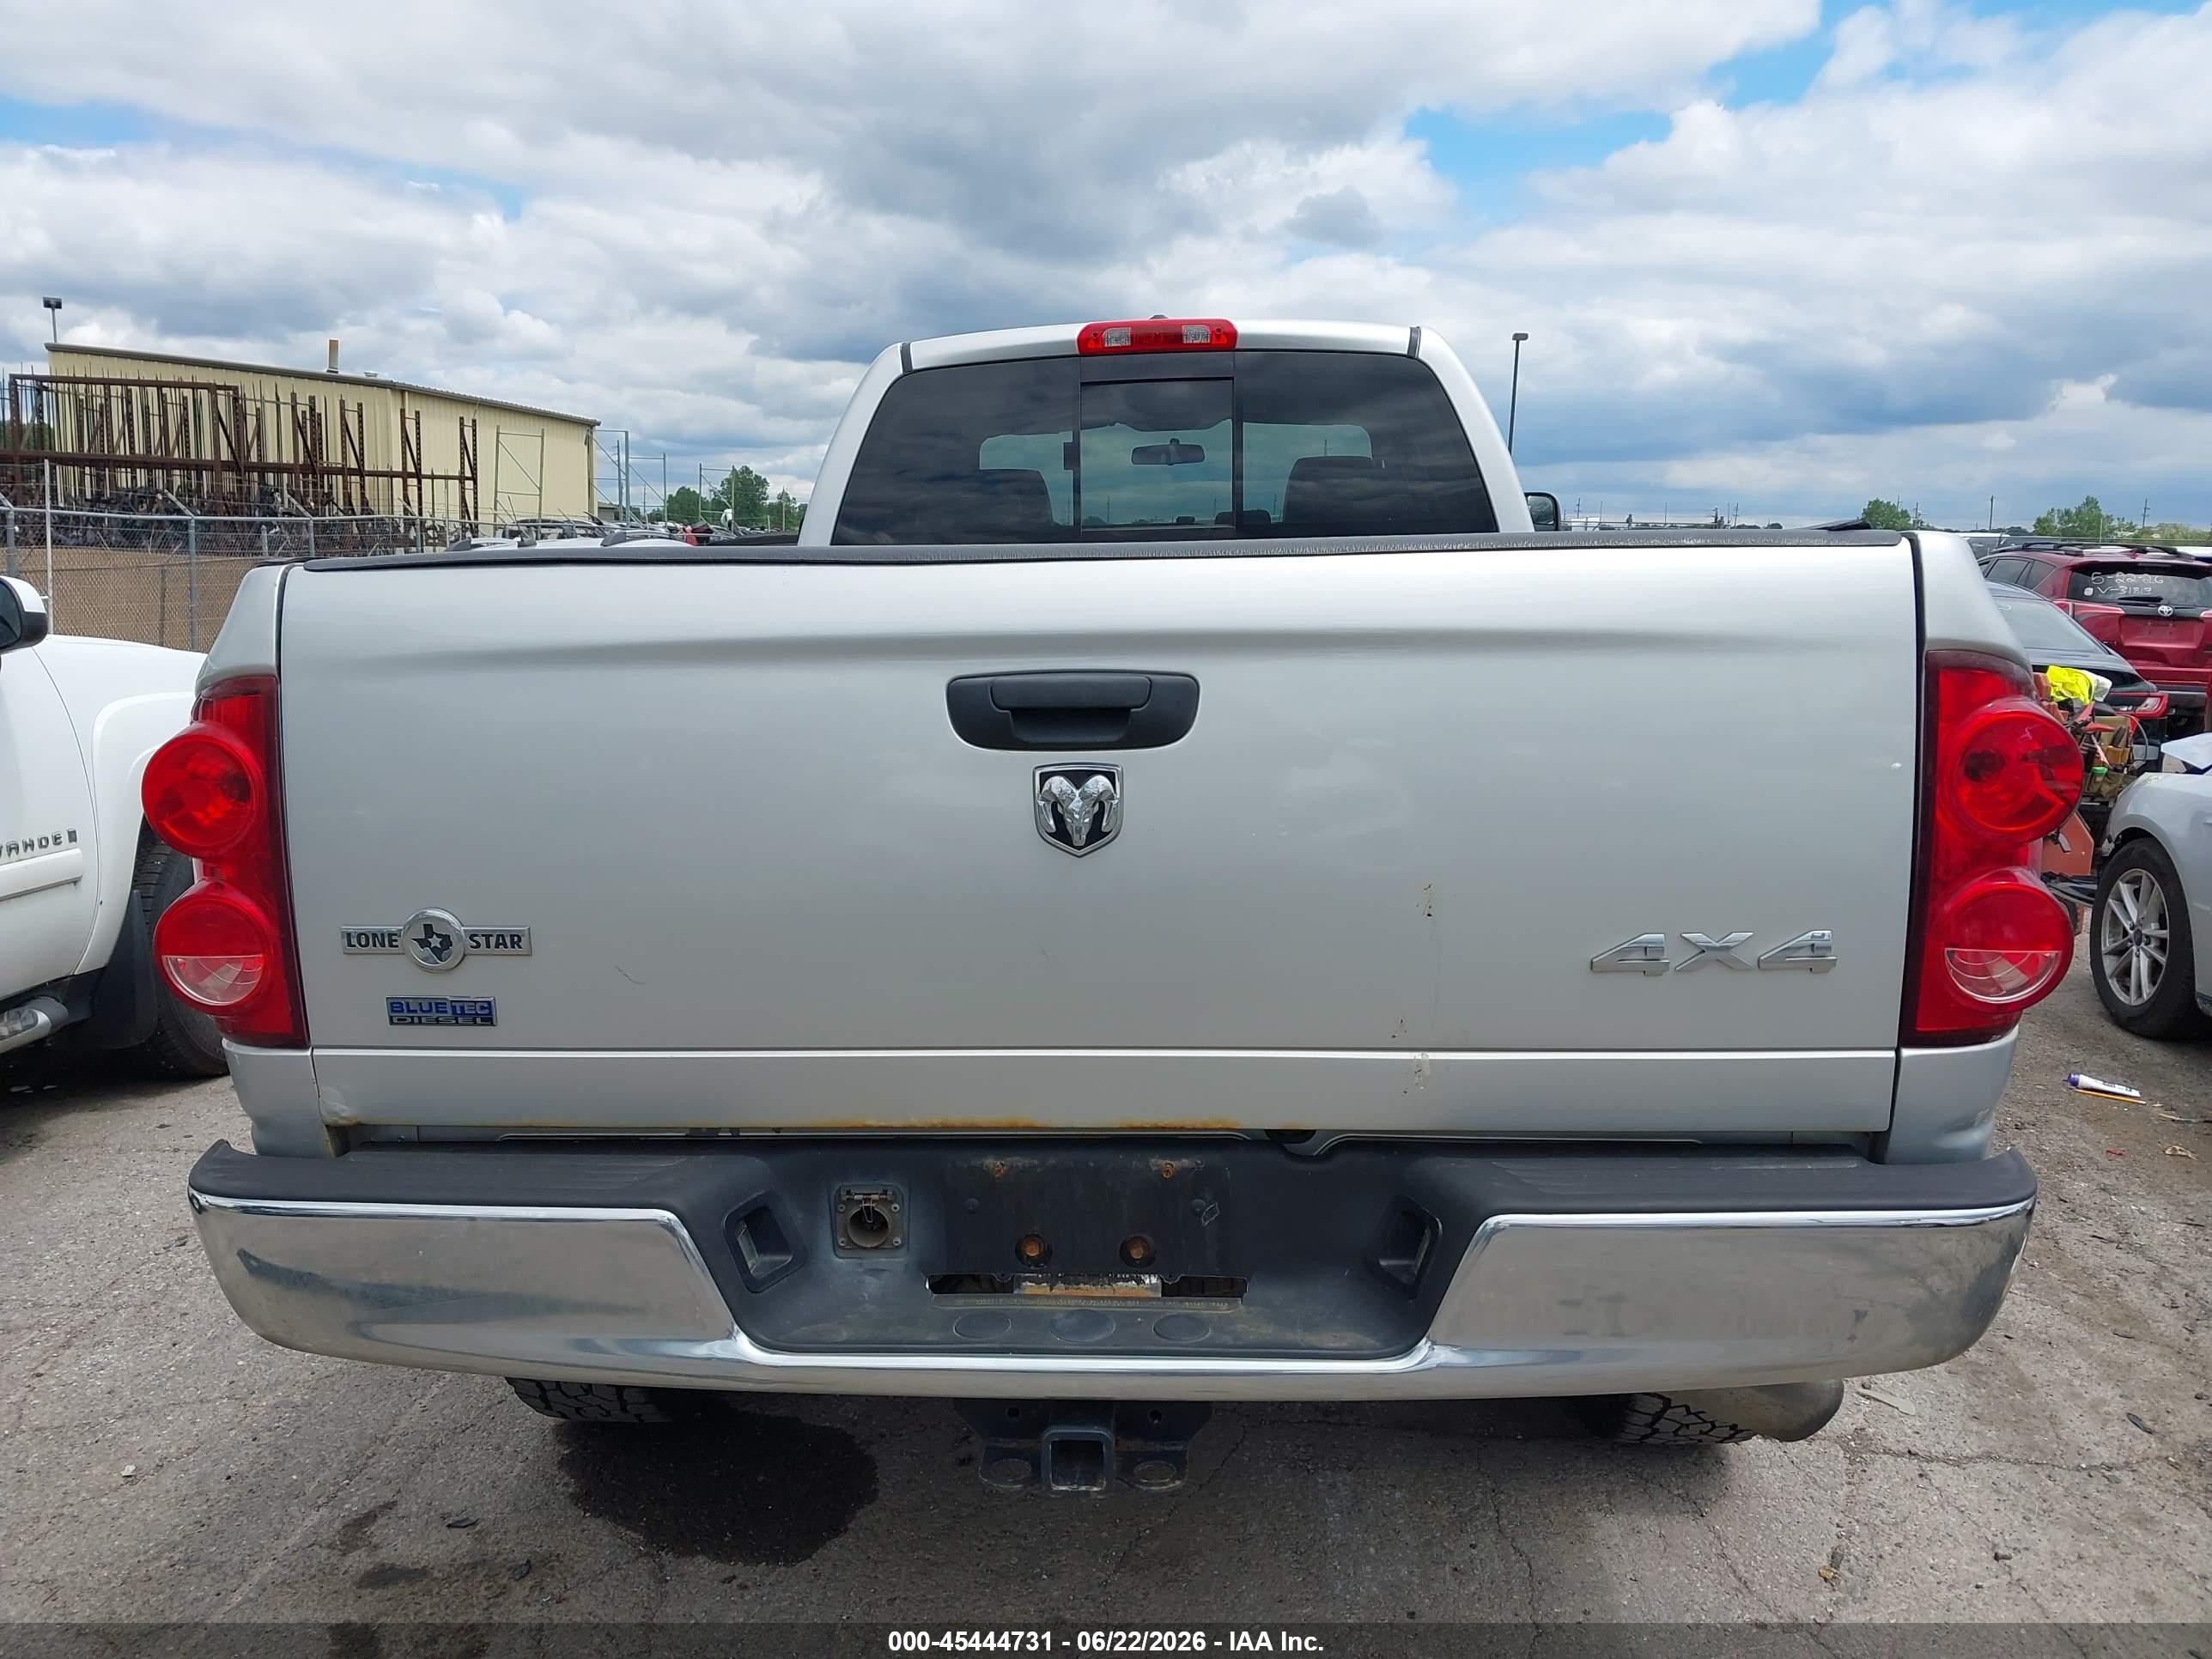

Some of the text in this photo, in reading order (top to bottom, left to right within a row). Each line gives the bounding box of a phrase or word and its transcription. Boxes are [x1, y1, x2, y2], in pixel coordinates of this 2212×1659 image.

[2091, 572, 2164, 585] 5-22-26
[346, 932, 523, 950] LONE STAR
[1590, 930, 1838, 975] 4X4
[389, 1000, 491, 1015] BLUETEC
[392, 1015, 492, 1025] DIESEL
